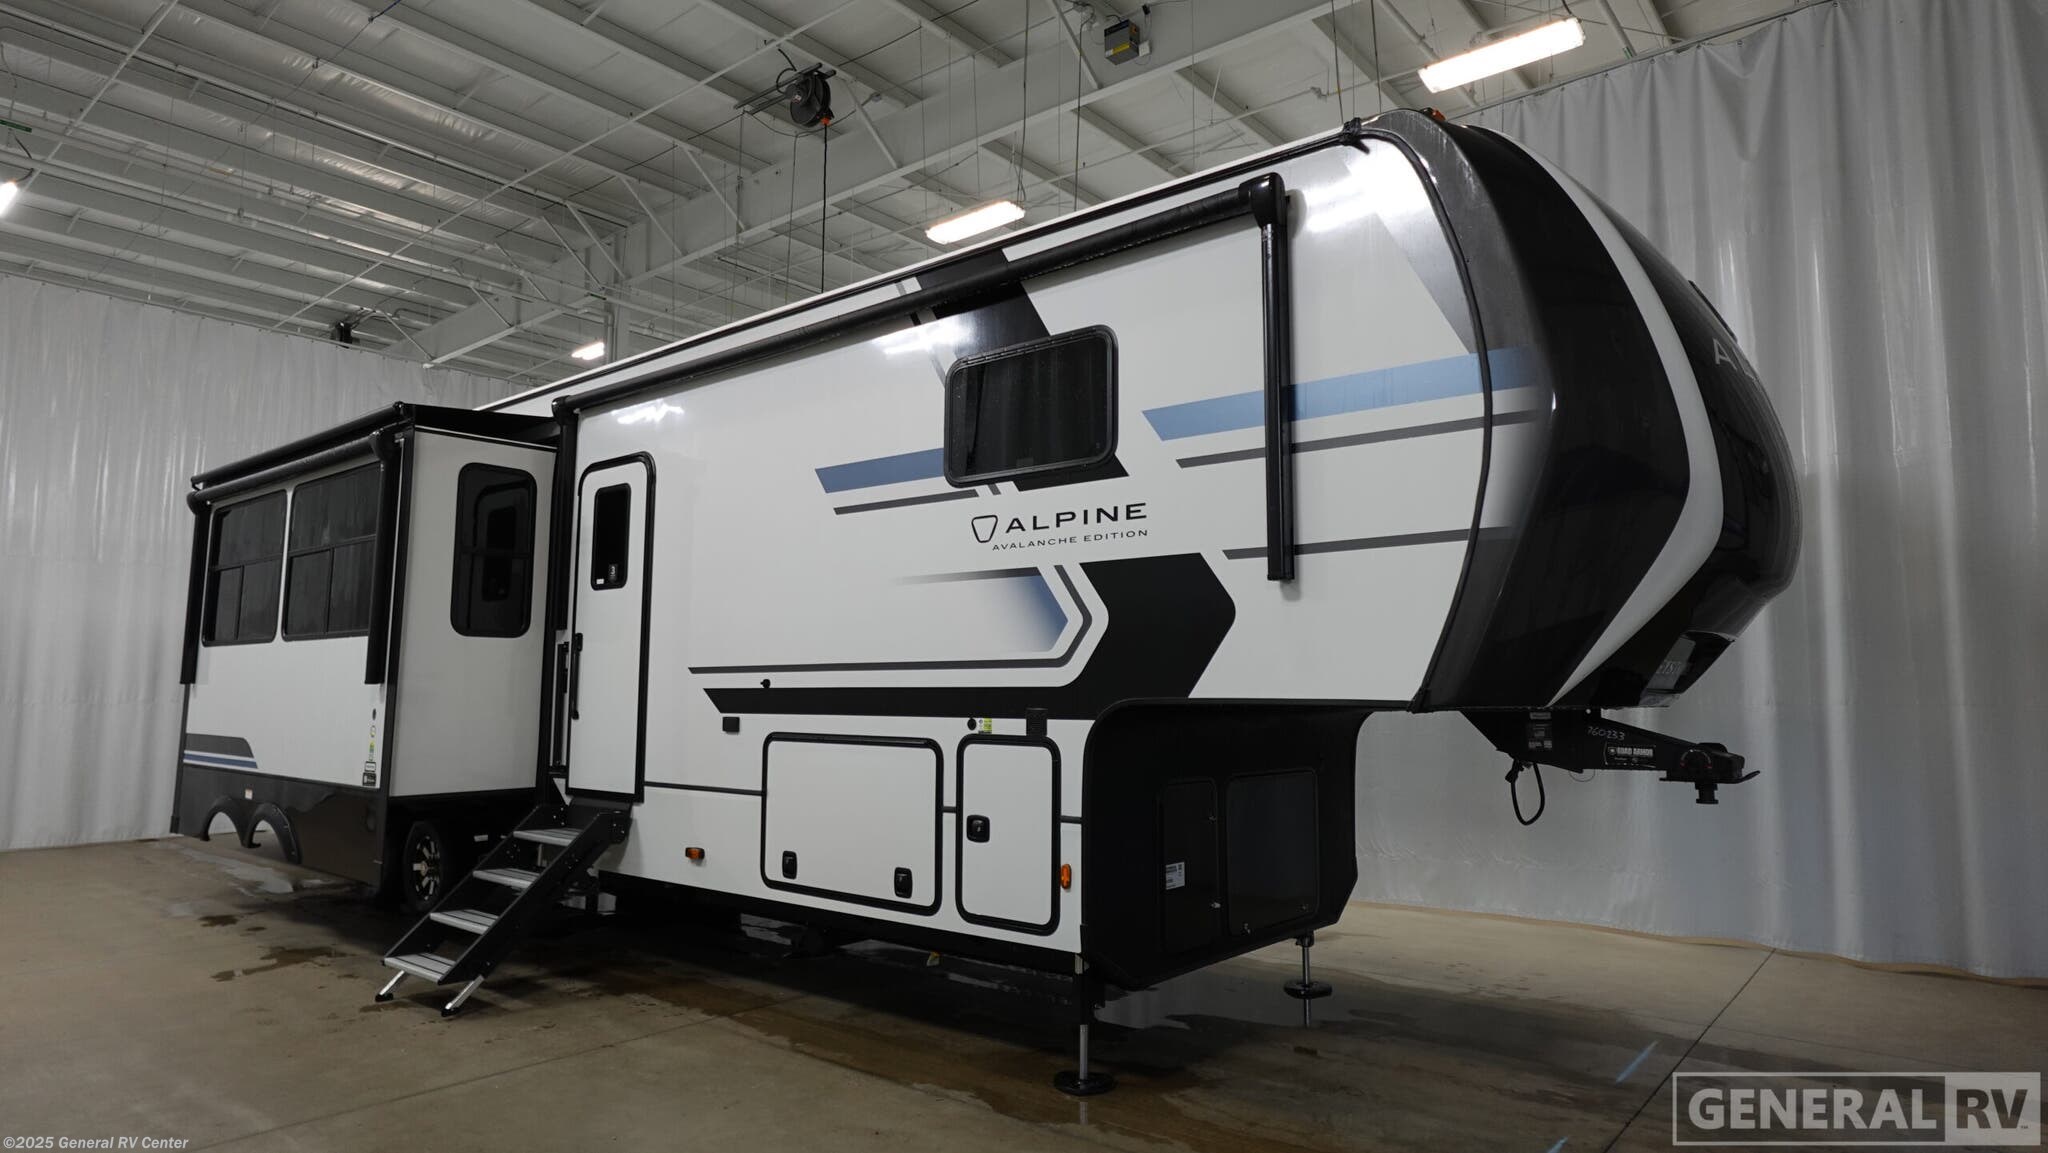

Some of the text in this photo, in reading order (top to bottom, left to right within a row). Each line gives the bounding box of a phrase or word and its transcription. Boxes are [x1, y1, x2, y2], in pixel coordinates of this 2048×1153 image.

[1005, 502, 1147, 534] ALPINE
[992, 529, 1148, 551] AVALANCHE EDITION
